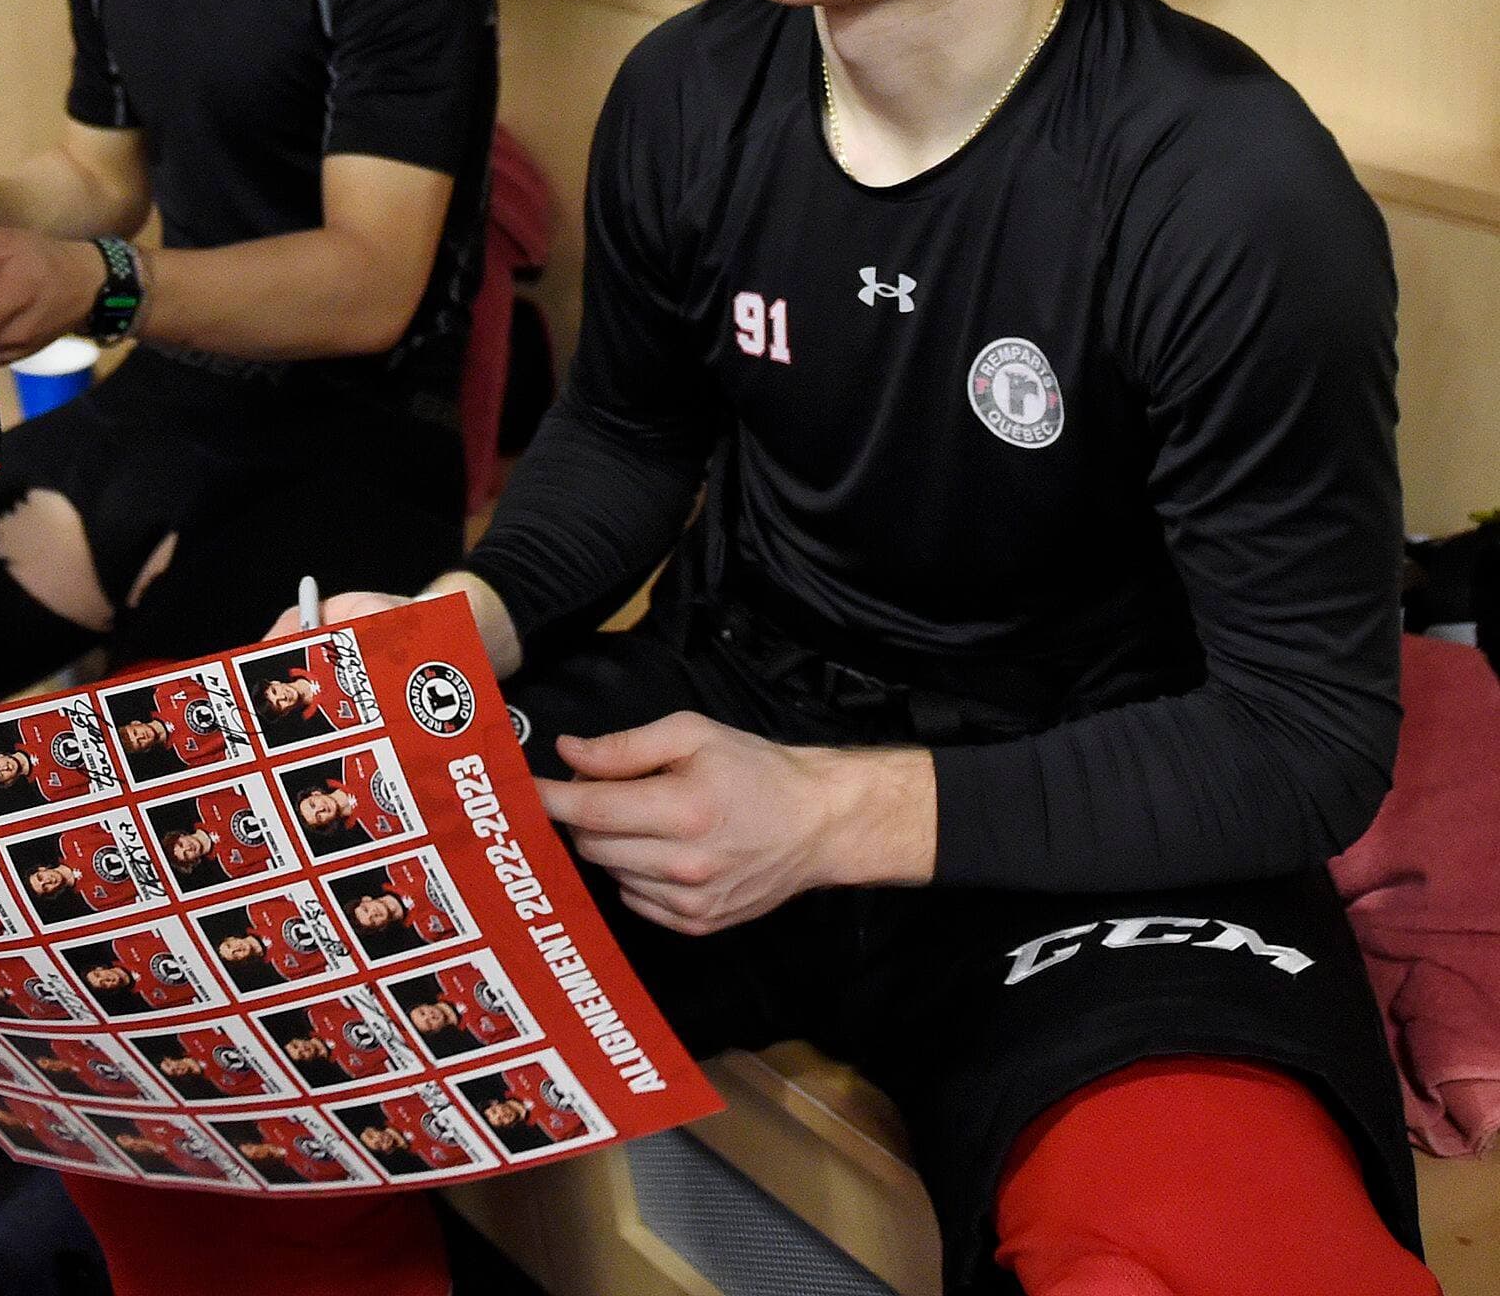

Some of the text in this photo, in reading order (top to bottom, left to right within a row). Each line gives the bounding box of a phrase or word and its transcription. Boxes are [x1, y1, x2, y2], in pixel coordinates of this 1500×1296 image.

[733, 291, 792, 365] 91
[979, 342, 1057, 390] REMPARTS
[408, 674, 444, 731] REMPARTS
[447, 753, 667, 1095] ALIGNEMENT 2022-2023
[1004, 916, 1316, 985] CCM
